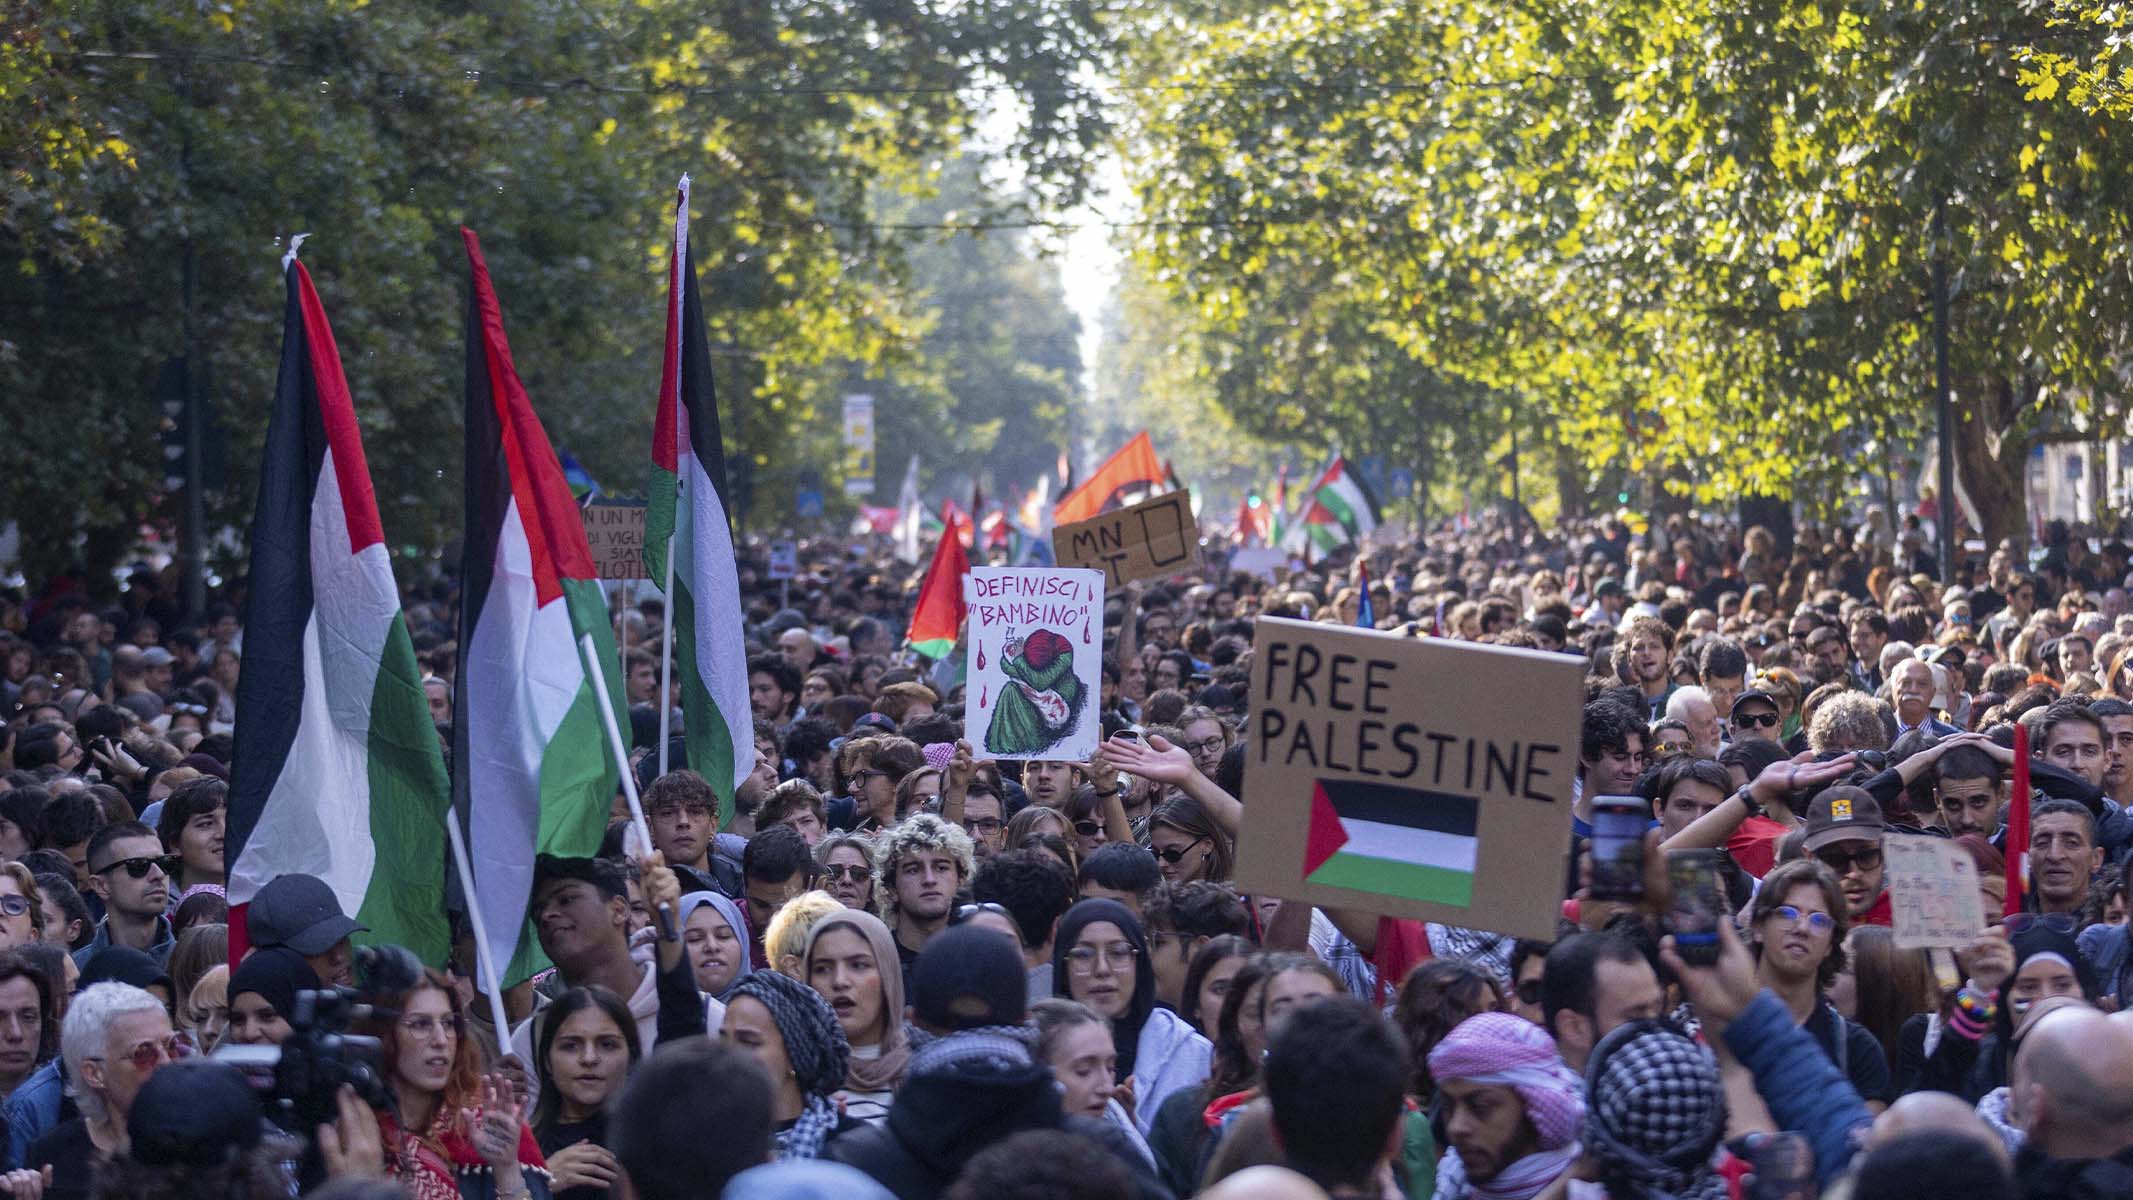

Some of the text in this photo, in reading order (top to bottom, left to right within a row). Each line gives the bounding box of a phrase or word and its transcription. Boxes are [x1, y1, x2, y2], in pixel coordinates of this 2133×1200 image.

[601, 510, 622, 525] UN
[1072, 520, 1122, 560] MN
[595, 560, 649, 579] LOTI
[974, 575, 1080, 600] DEFINISCI
[969, 603, 1088, 627] "BAMBINO"
[1265, 642, 1398, 714] FREE
[1260, 708, 1561, 802] PALESTINE
